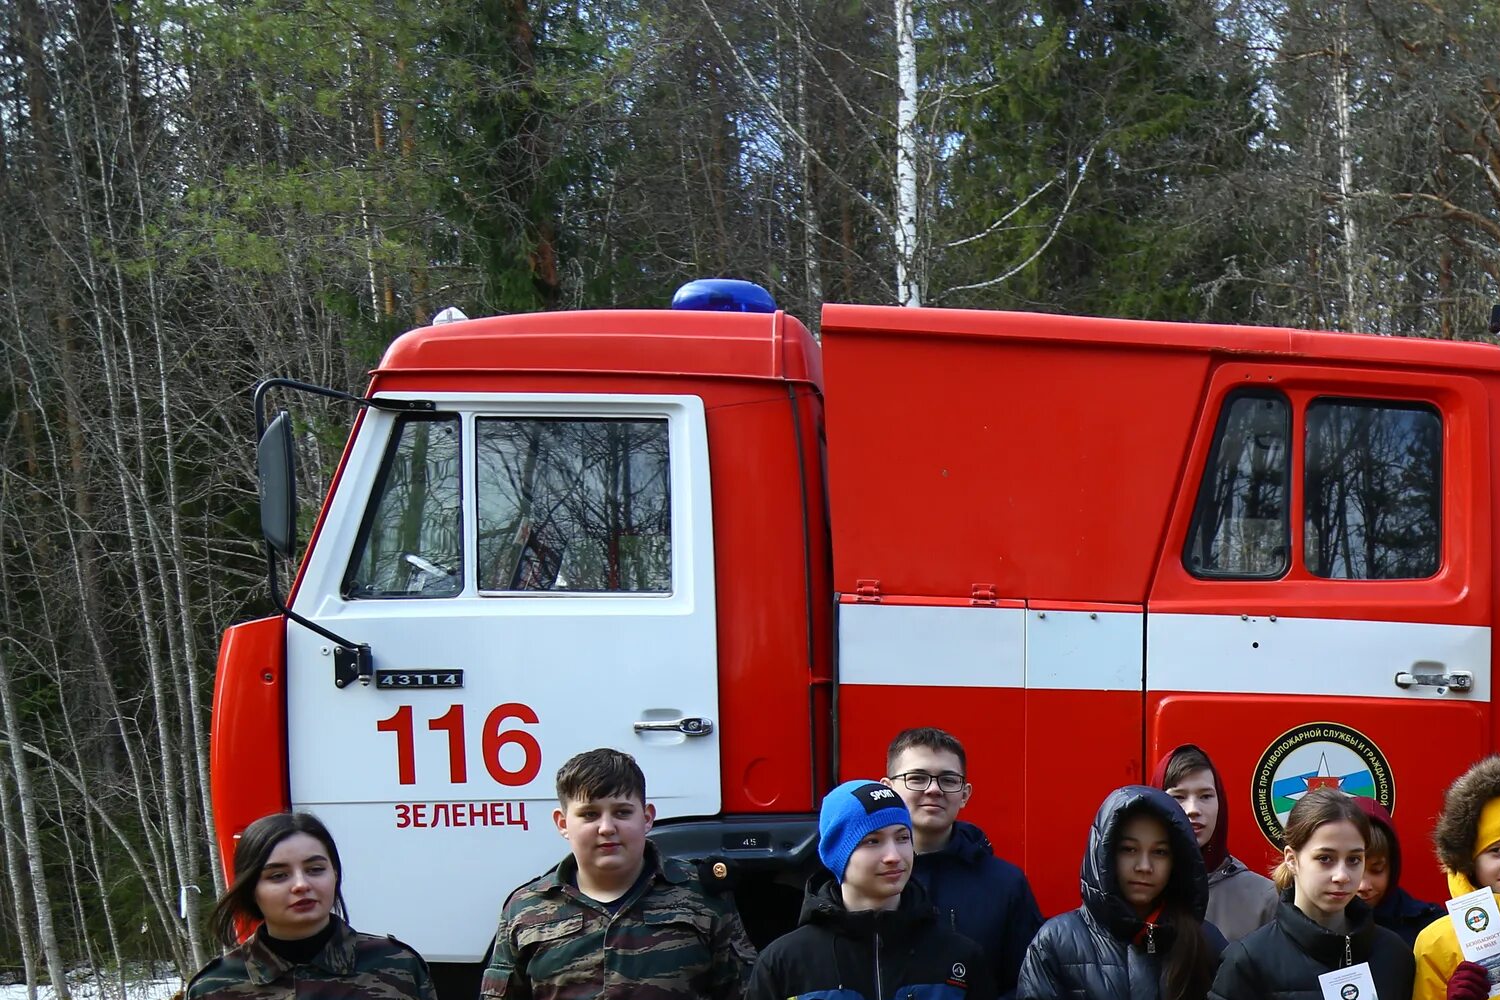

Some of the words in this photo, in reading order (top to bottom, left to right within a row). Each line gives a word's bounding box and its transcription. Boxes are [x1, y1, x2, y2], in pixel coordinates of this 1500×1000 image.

[381, 674, 457, 685] 43114
[376, 703, 542, 786] 116
[1323, 729, 1358, 747] СЛУЖБЫ
[1358, 742, 1366, 751] И
[1260, 728, 1322, 787] ПРОТИВОПОЖАРНОЙ
[1363, 748, 1389, 806] ГРАЖДАНСКОЙ
[870, 789, 895, 801] SPORT
[395, 802, 528, 830] ЗЕЛЕНЕЦ
[1258, 788, 1284, 841] УПРАВЛЕНИЕ
[743, 838, 757, 846] 45
